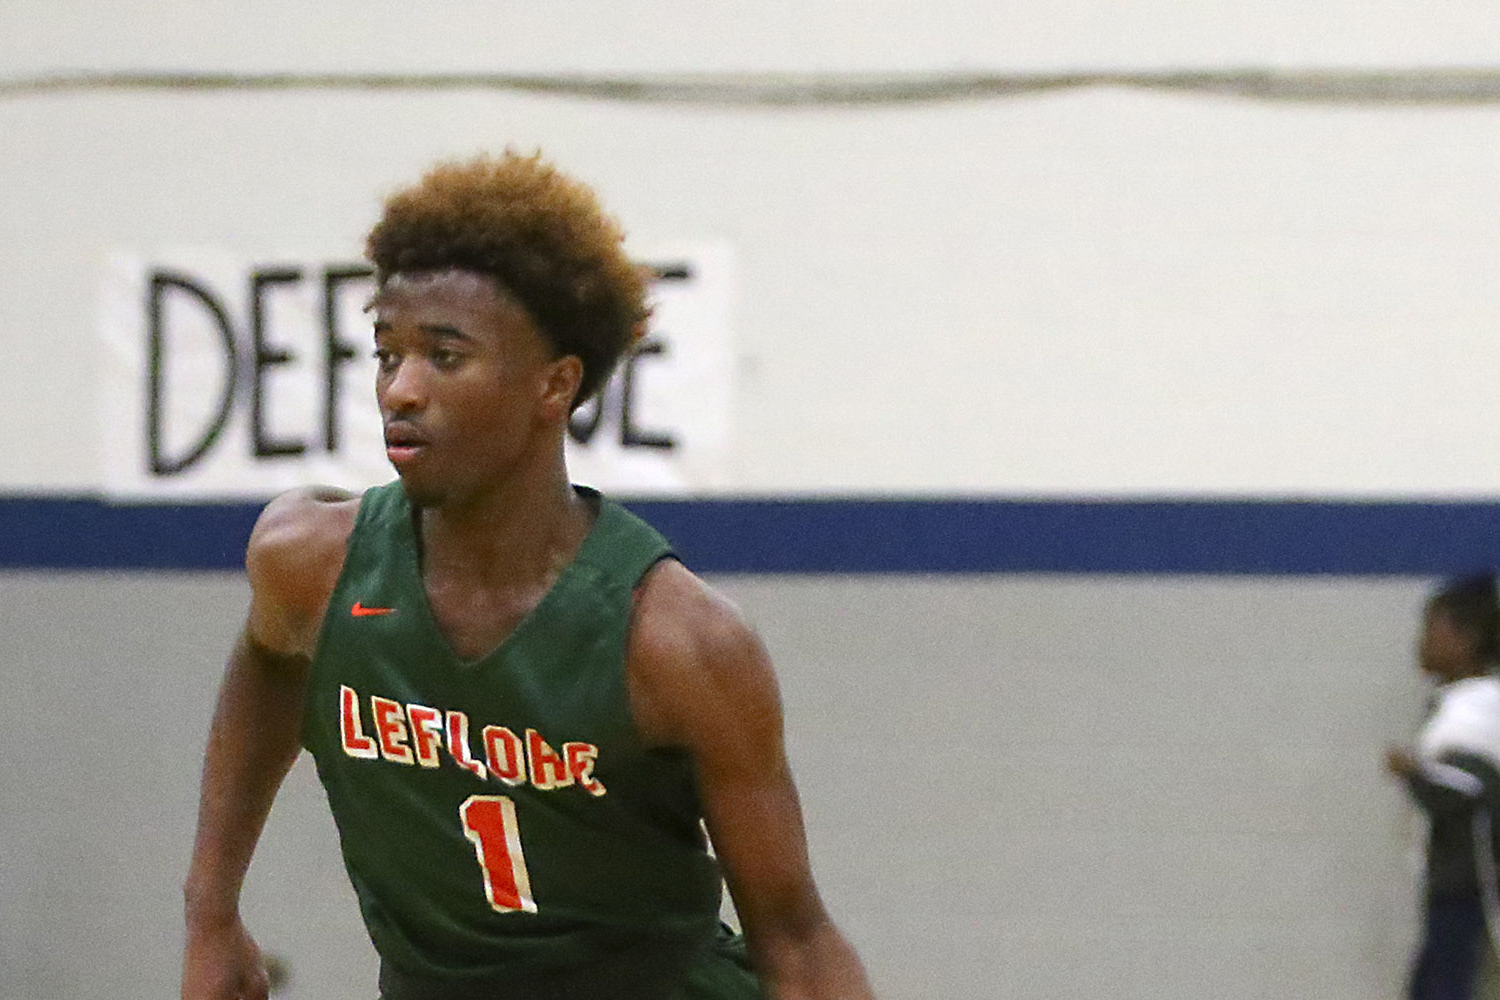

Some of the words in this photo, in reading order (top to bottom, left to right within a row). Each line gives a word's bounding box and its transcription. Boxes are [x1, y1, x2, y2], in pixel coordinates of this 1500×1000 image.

[144, 264, 692, 475] DEFE
[339, 684, 607, 796] LEFLORE
[459, 795, 538, 914] 1
